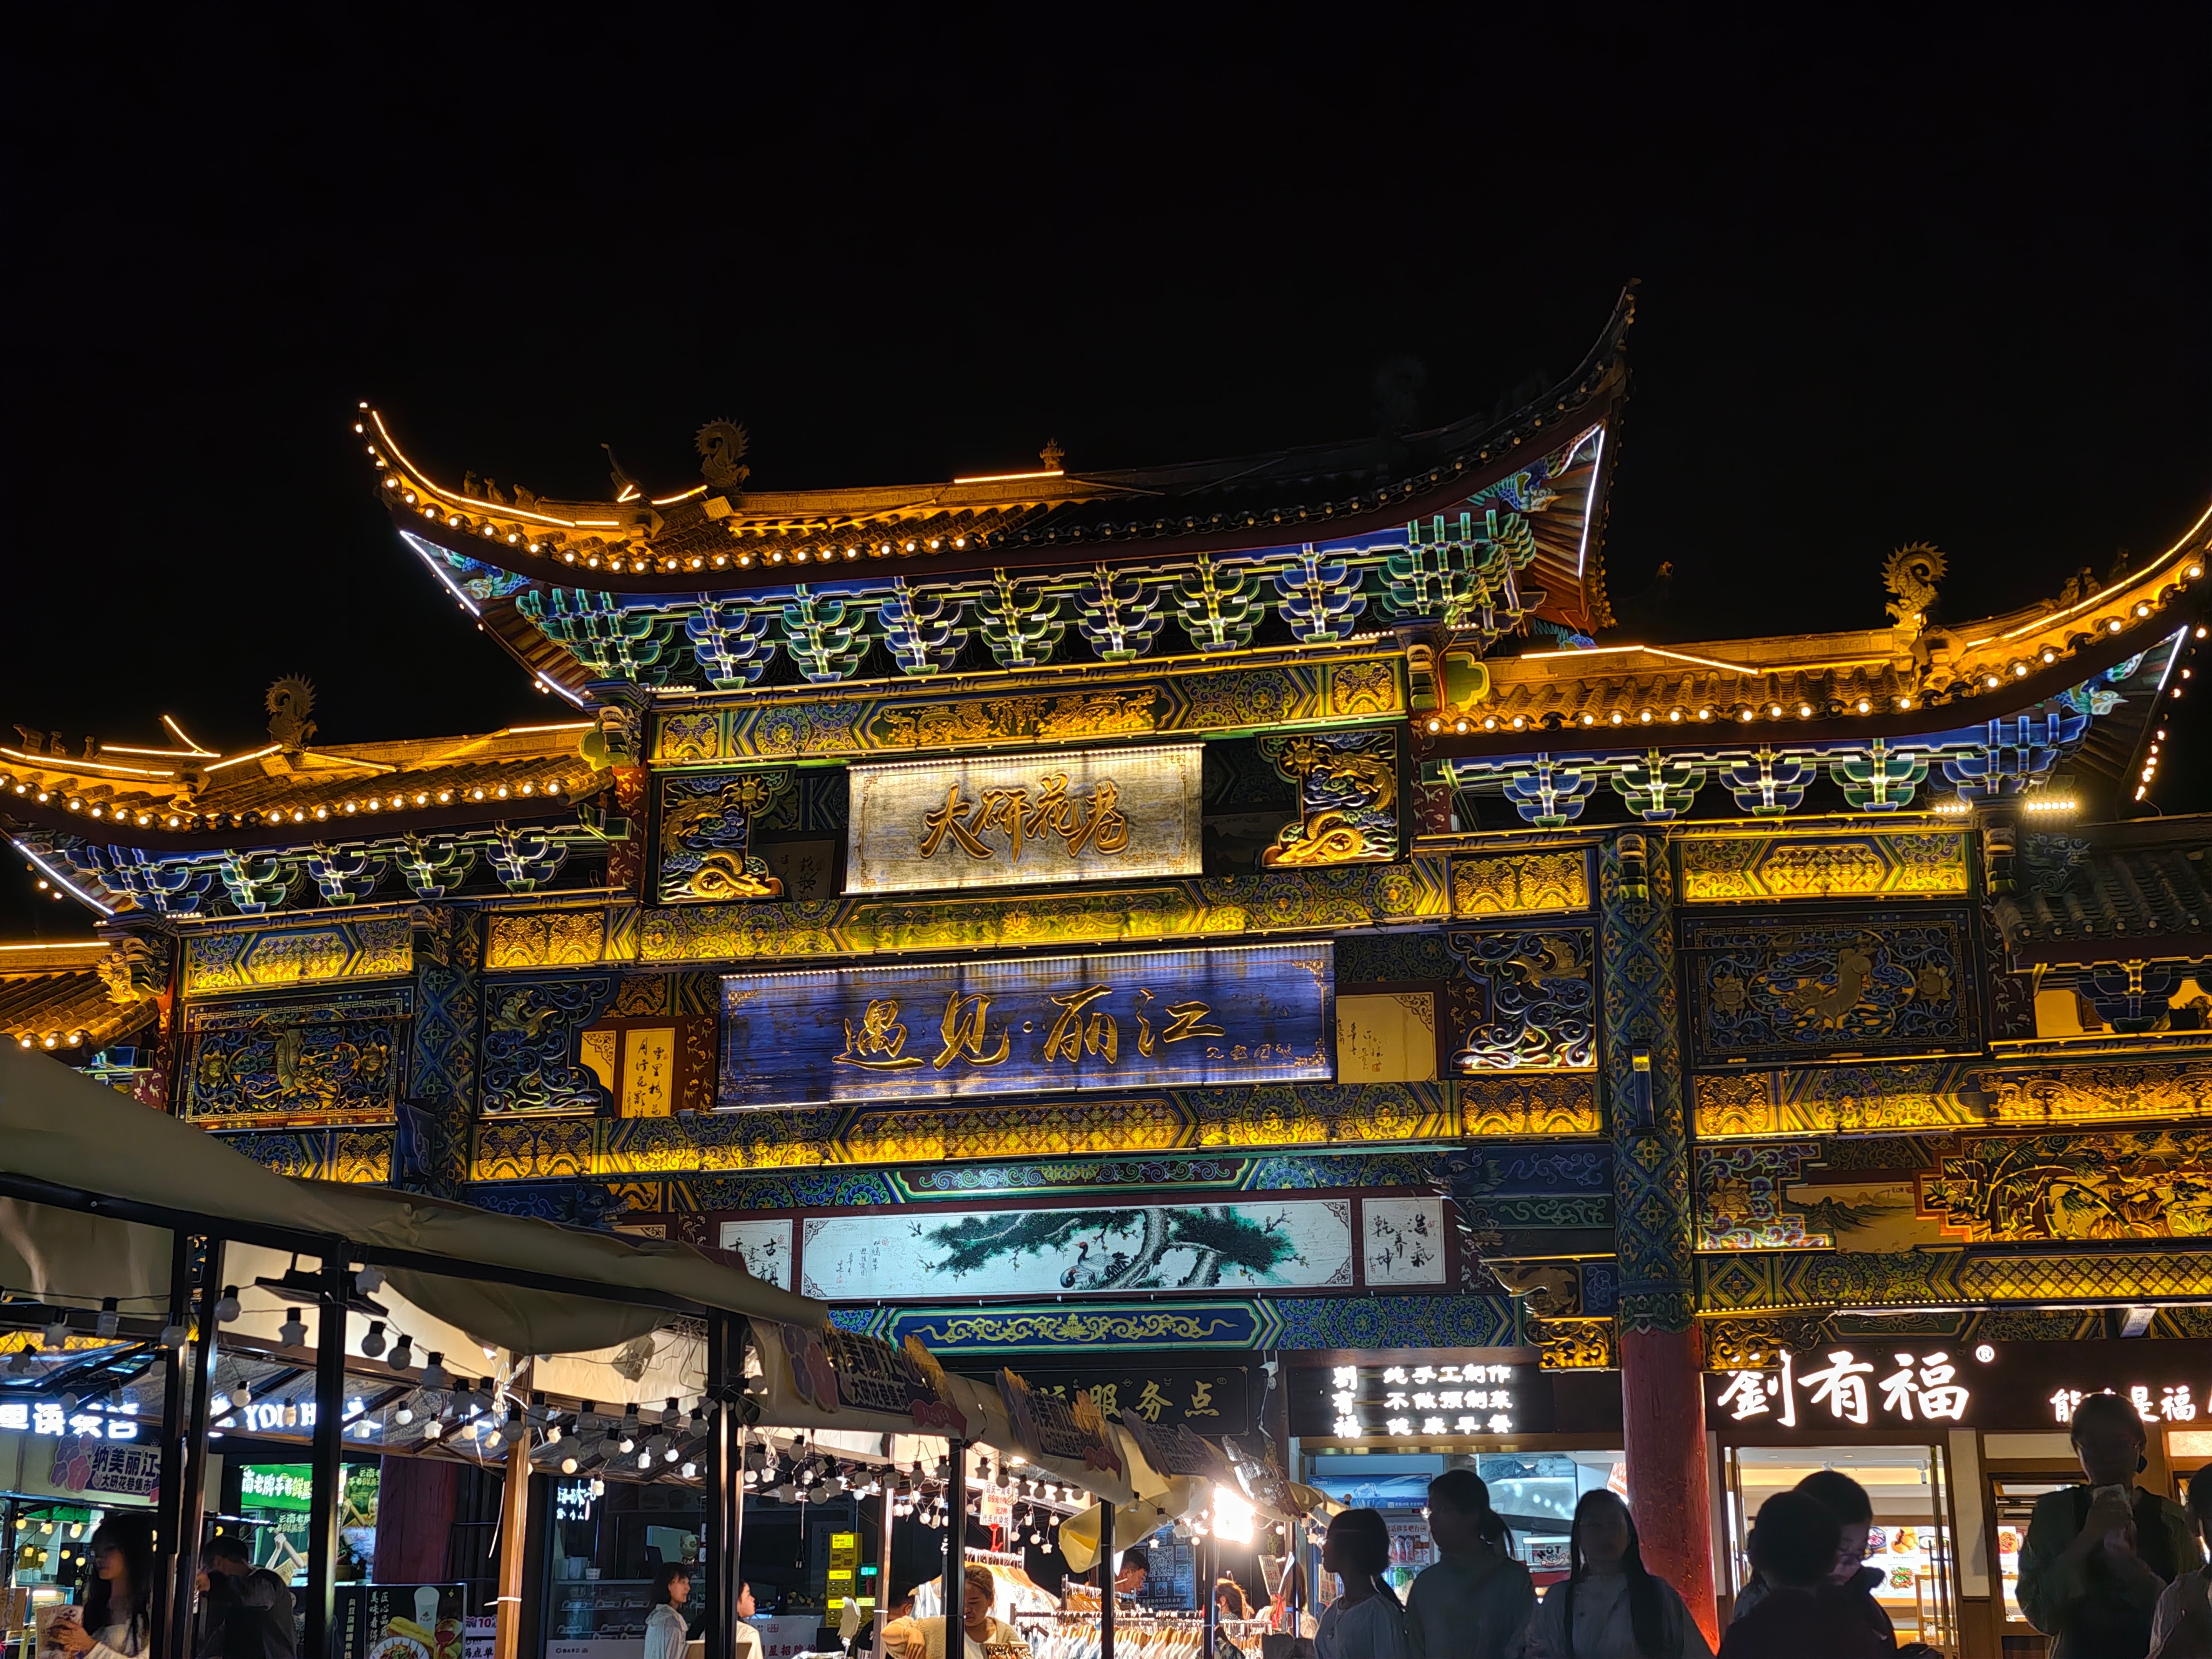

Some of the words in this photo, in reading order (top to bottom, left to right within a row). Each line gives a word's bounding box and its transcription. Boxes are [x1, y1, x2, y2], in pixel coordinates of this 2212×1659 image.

[920, 773, 1130, 865] 大研花巷
[1040, 1379, 1220, 1421] 服务点
[2049, 1386, 2212, 1422] 能是福
[92, 1445, 159, 1478] 纳美丽江
[102, 1474, 152, 1492] 大研花巷集市
[1537, 1546, 1562, 1560] HOT
